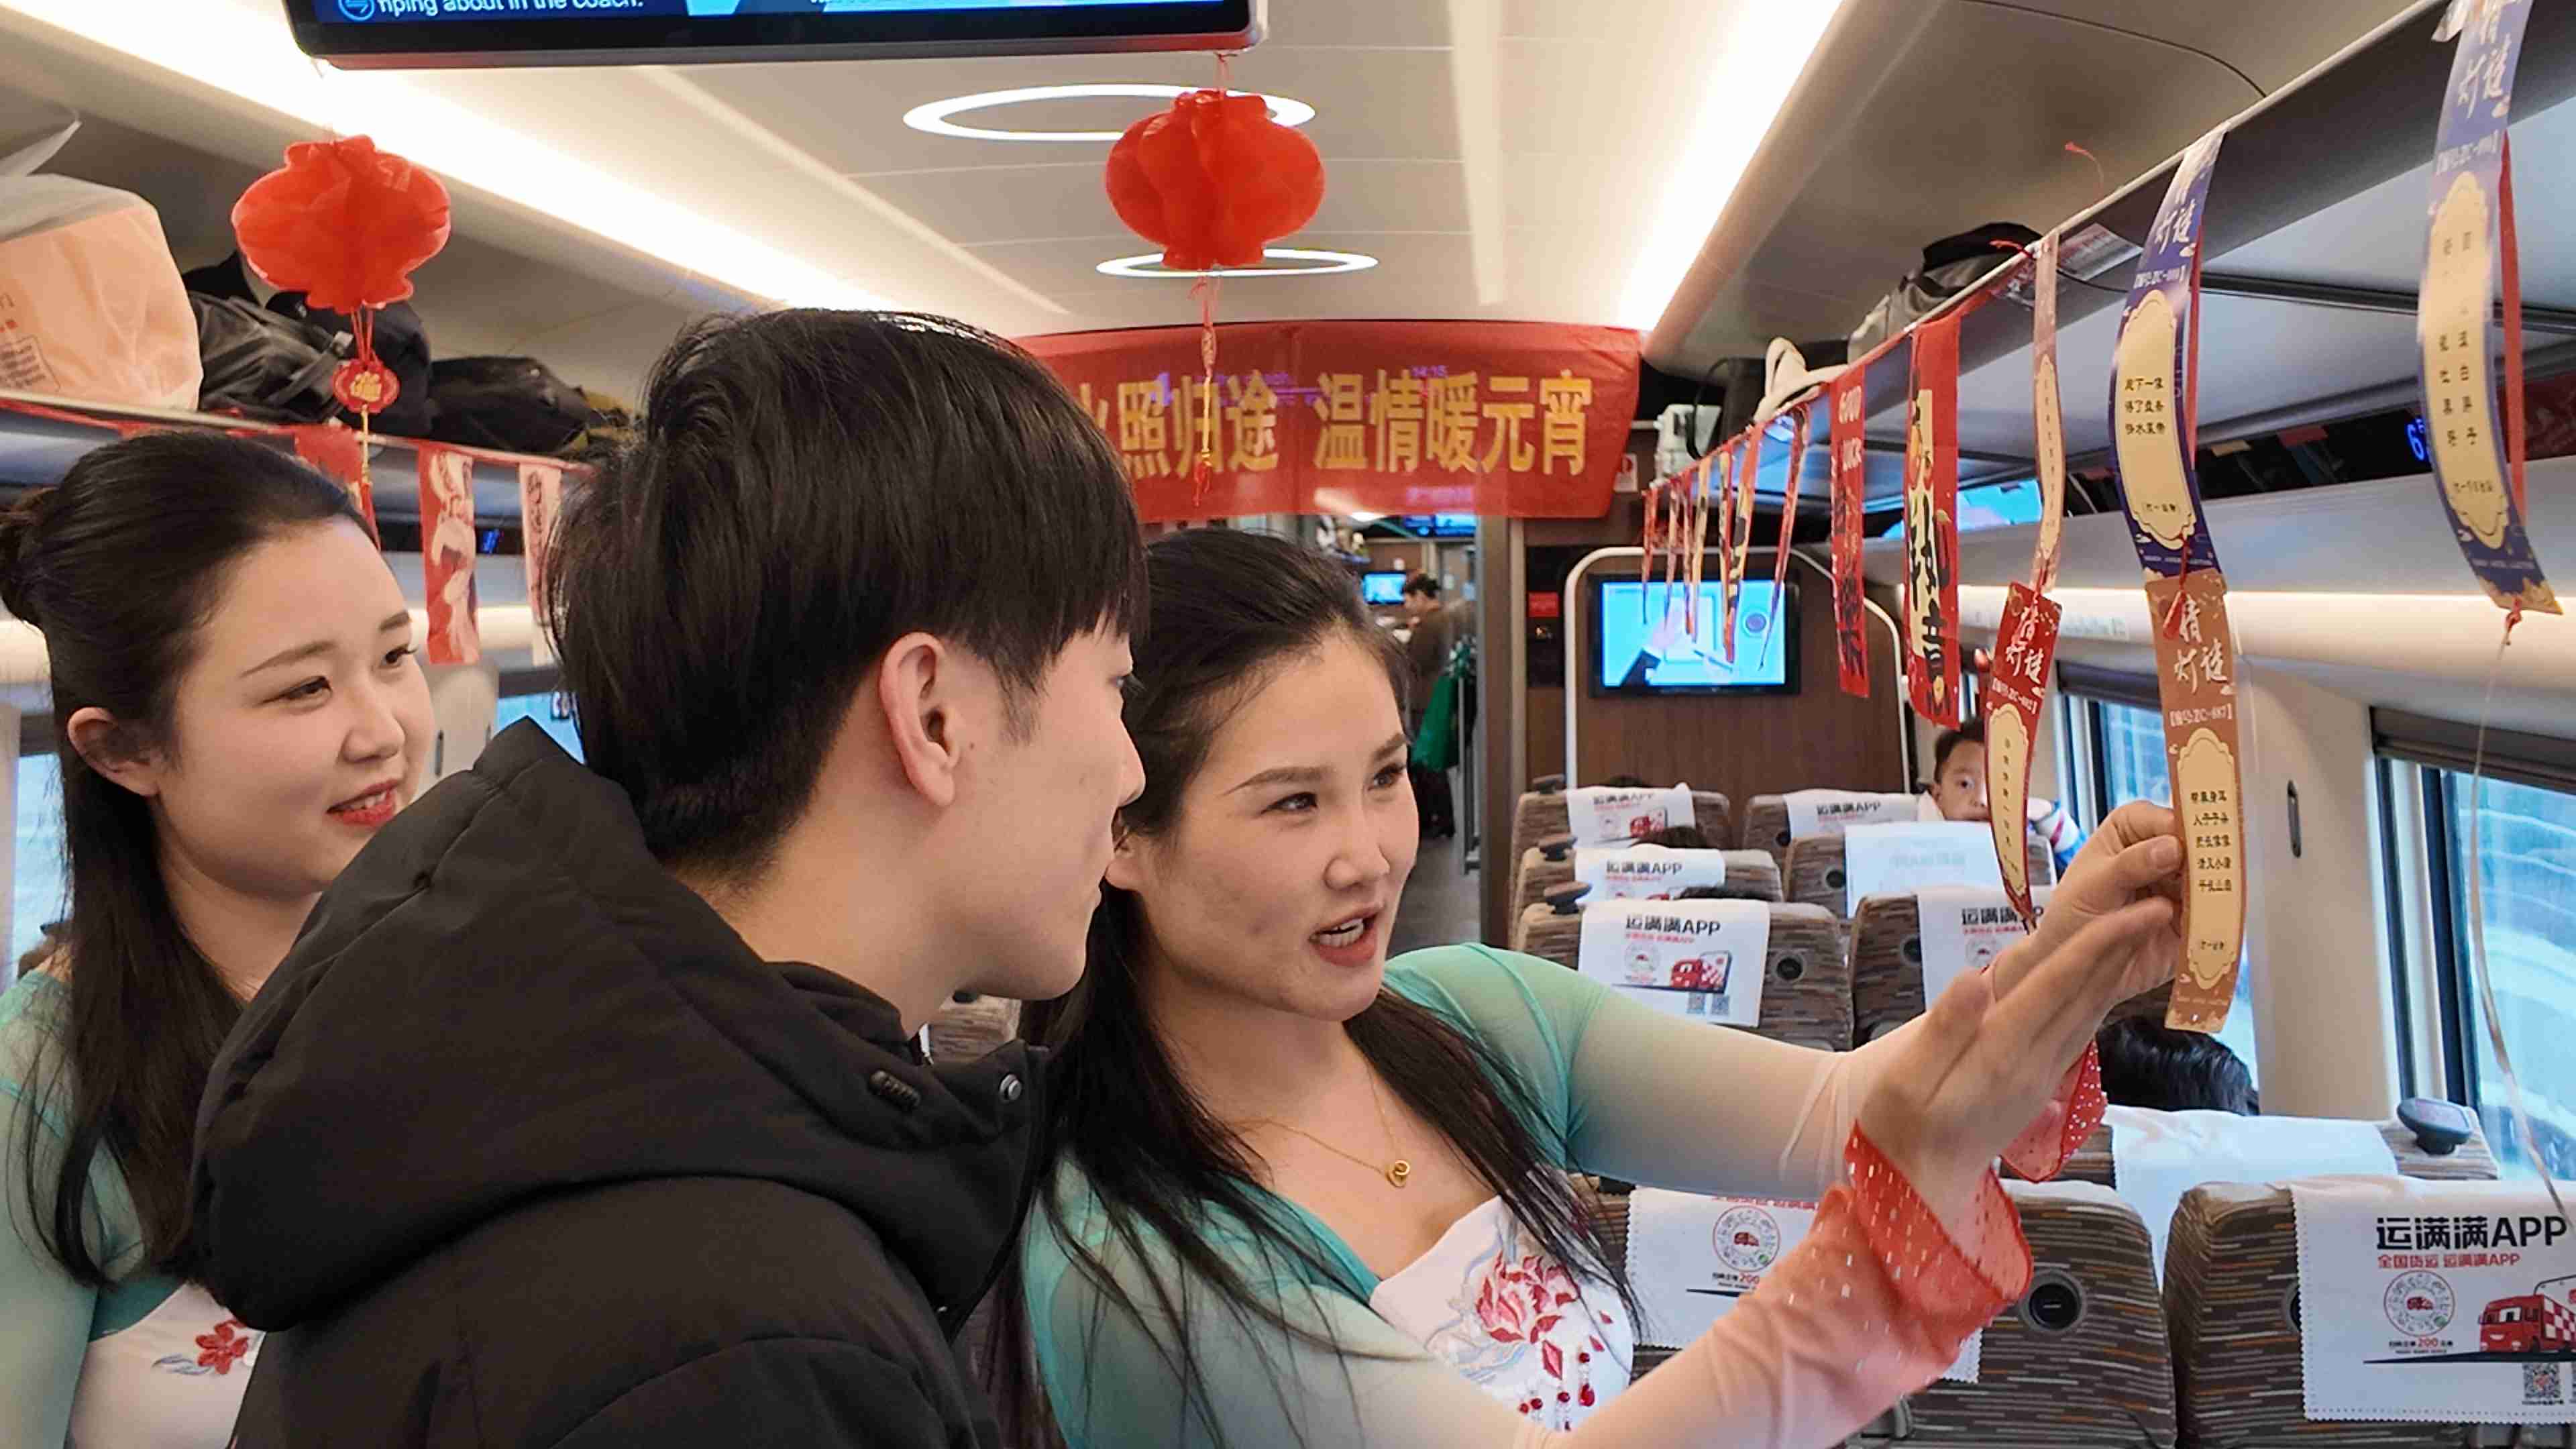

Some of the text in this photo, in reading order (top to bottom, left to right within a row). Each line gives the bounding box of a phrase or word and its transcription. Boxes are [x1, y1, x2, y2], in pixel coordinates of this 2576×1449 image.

[1079, 369, 1591, 480] 照归途 温情暖元宵
[1625, 915, 1721, 936] 运满满APP
[2376, 1215, 2568, 1250] 运满满APP
[2443, 1252, 2520, 1269] 运满满APP
